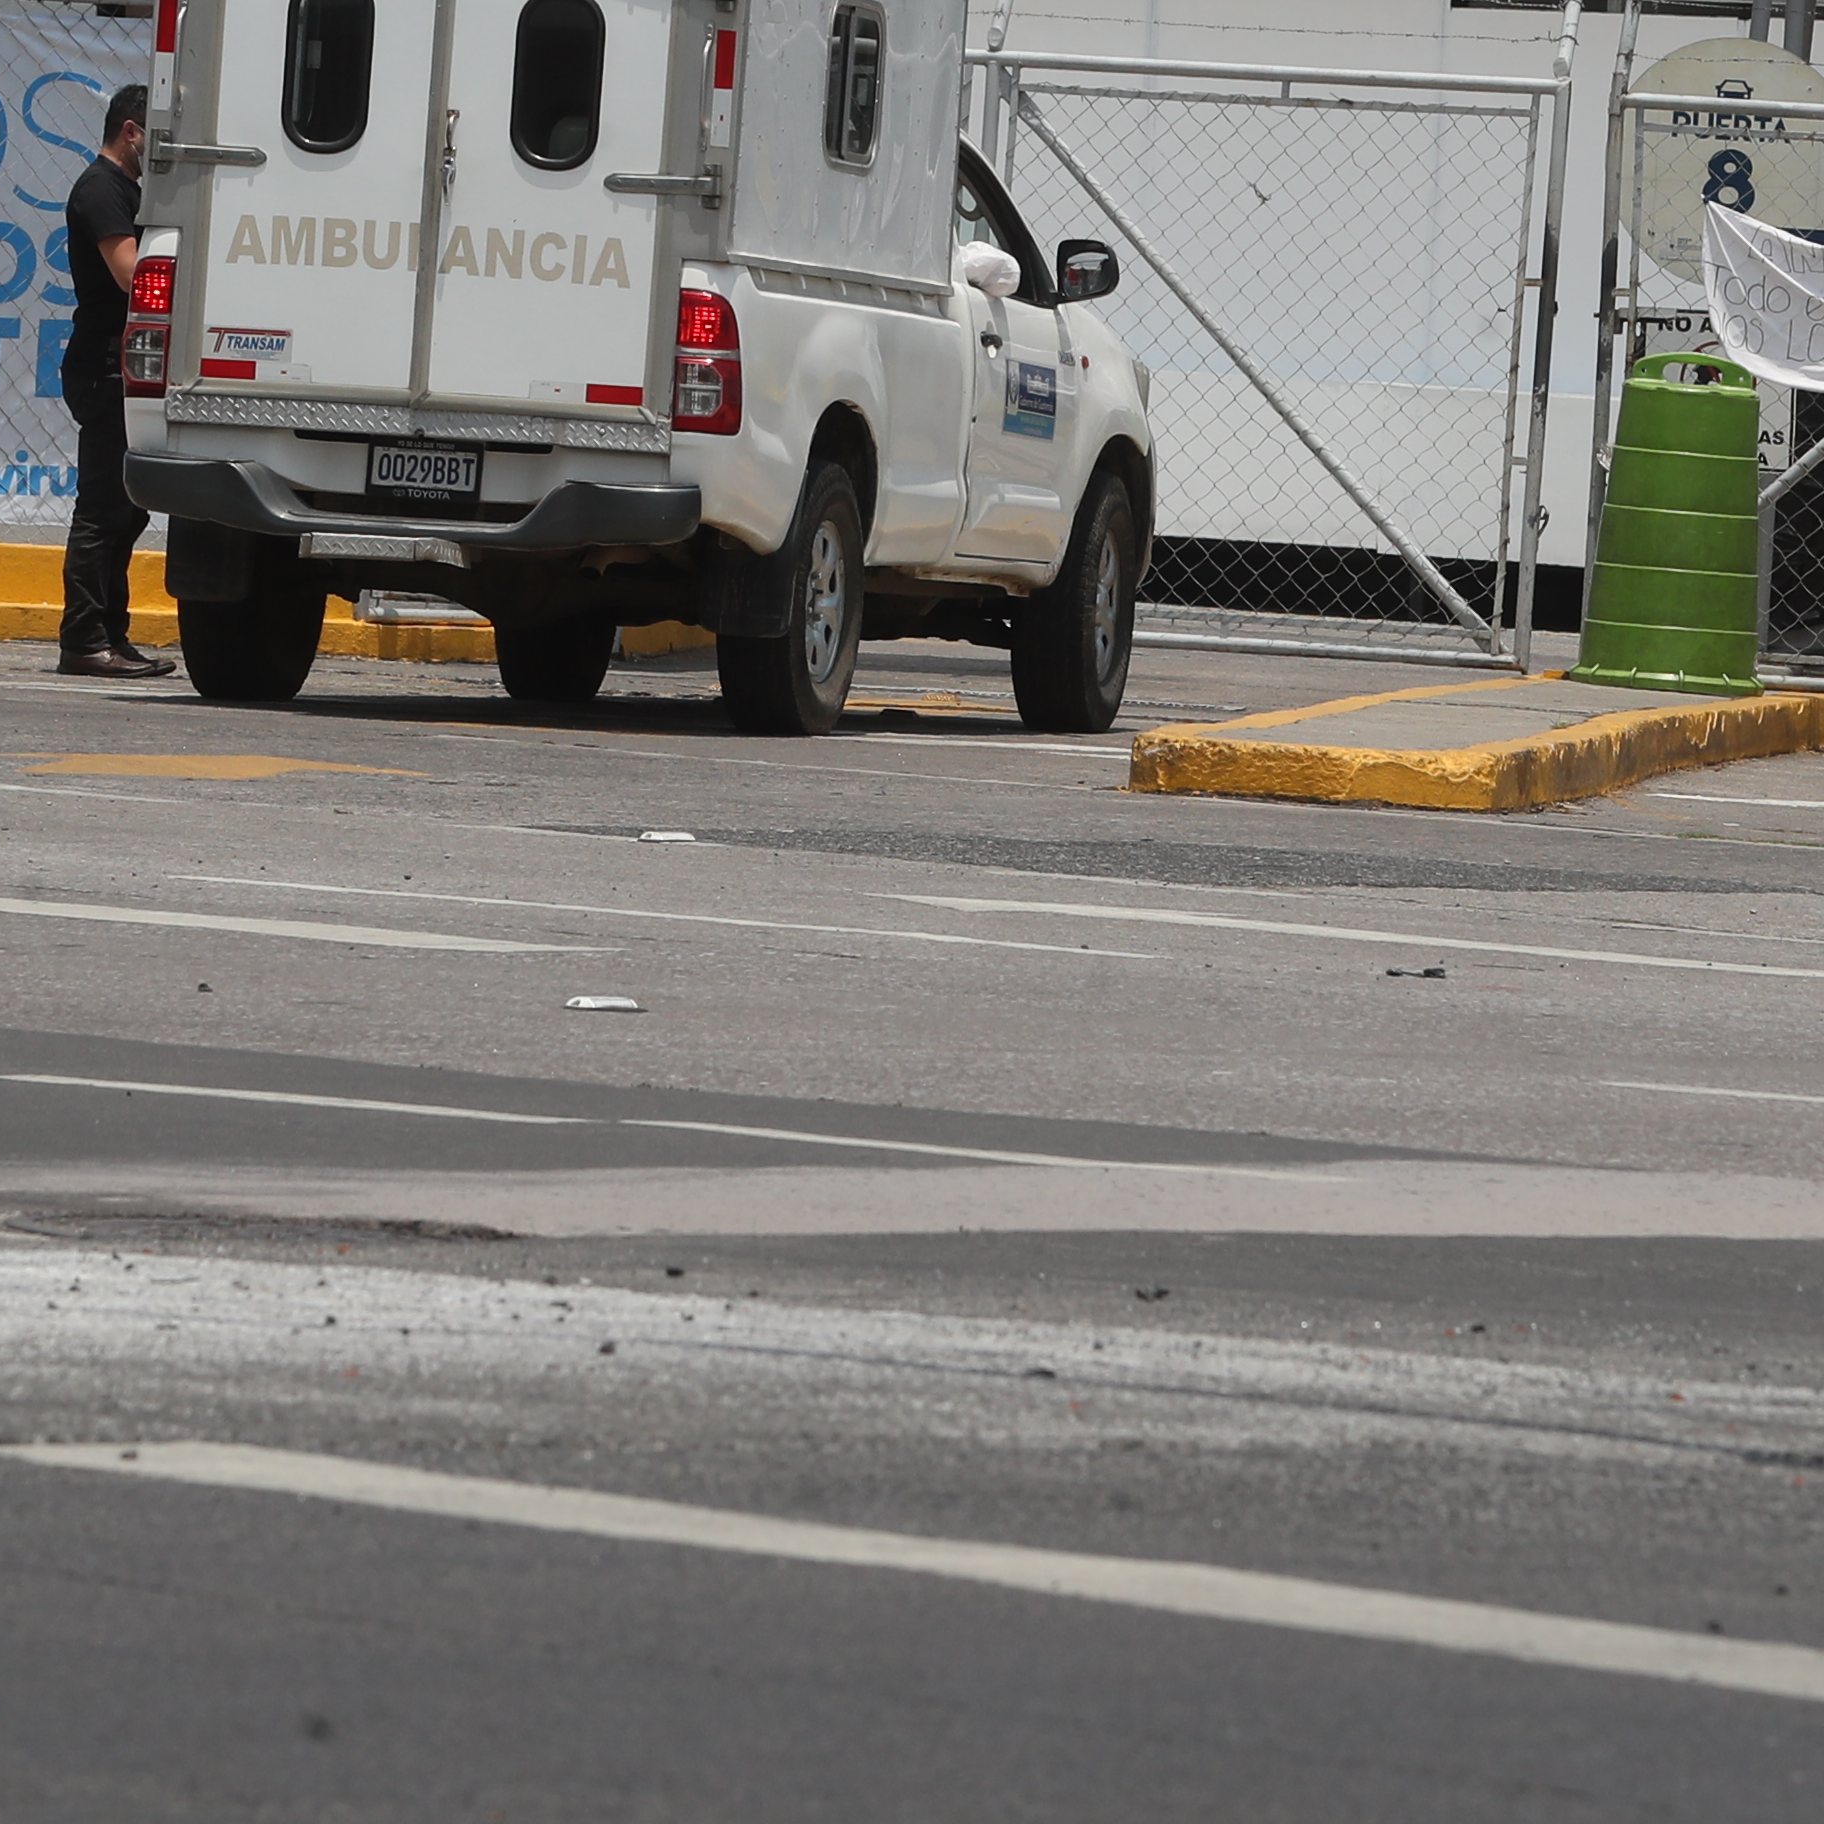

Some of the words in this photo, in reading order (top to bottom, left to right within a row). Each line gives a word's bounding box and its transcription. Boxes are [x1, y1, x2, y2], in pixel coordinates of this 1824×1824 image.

[1672, 110, 1790, 144] PUERTA
[1702, 149, 1756, 214] 8
[1704, 260, 1792, 314] Todo
[226, 335, 286, 352] TRANSAM
[378, 453, 475, 486] 0029BBT
[407, 488, 451, 500] TOYOTA
